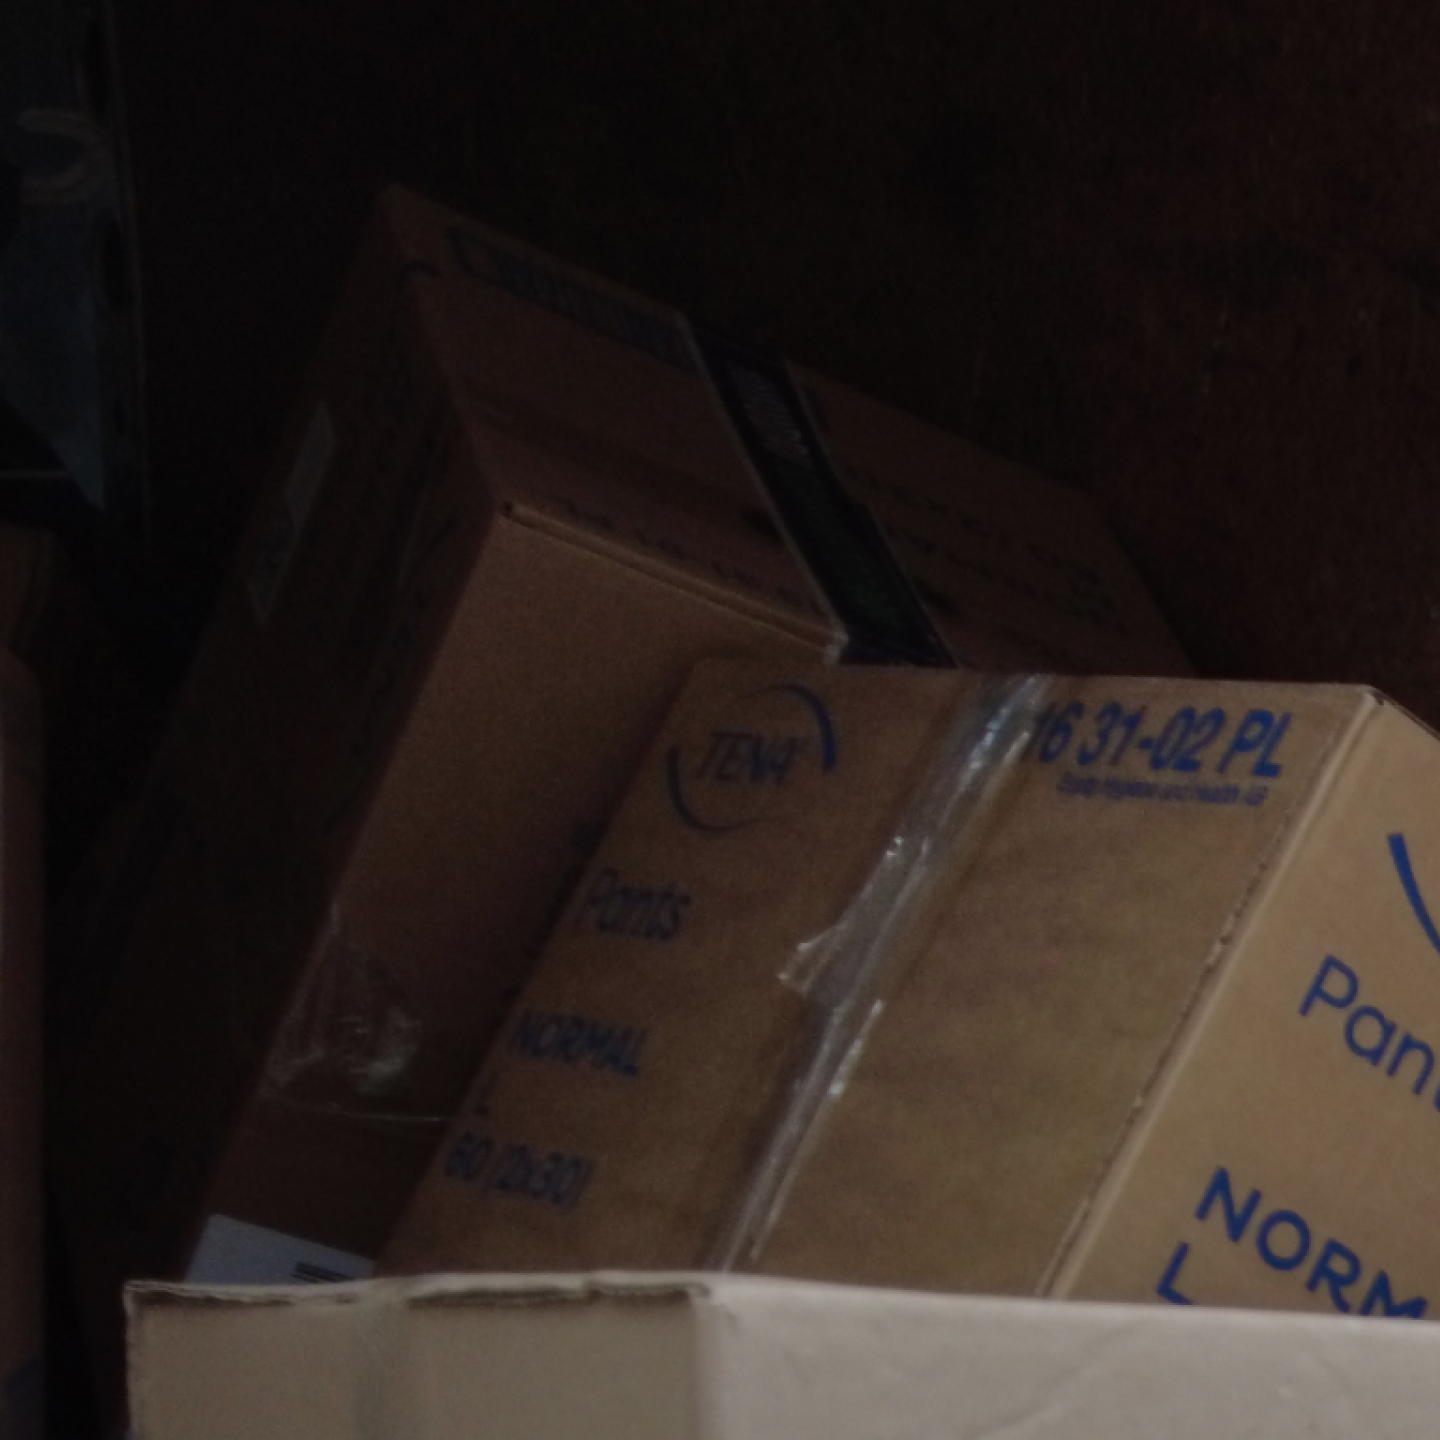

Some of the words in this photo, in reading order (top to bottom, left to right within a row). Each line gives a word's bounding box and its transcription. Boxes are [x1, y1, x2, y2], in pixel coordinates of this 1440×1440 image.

[697, 730, 799, 784] TENA
[1075, 701, 1226, 772] 31-02
[1216, 708, 1292, 777] PL
[573, 867, 692, 940] Pants
[511, 1010, 648, 1076] NORMAL
